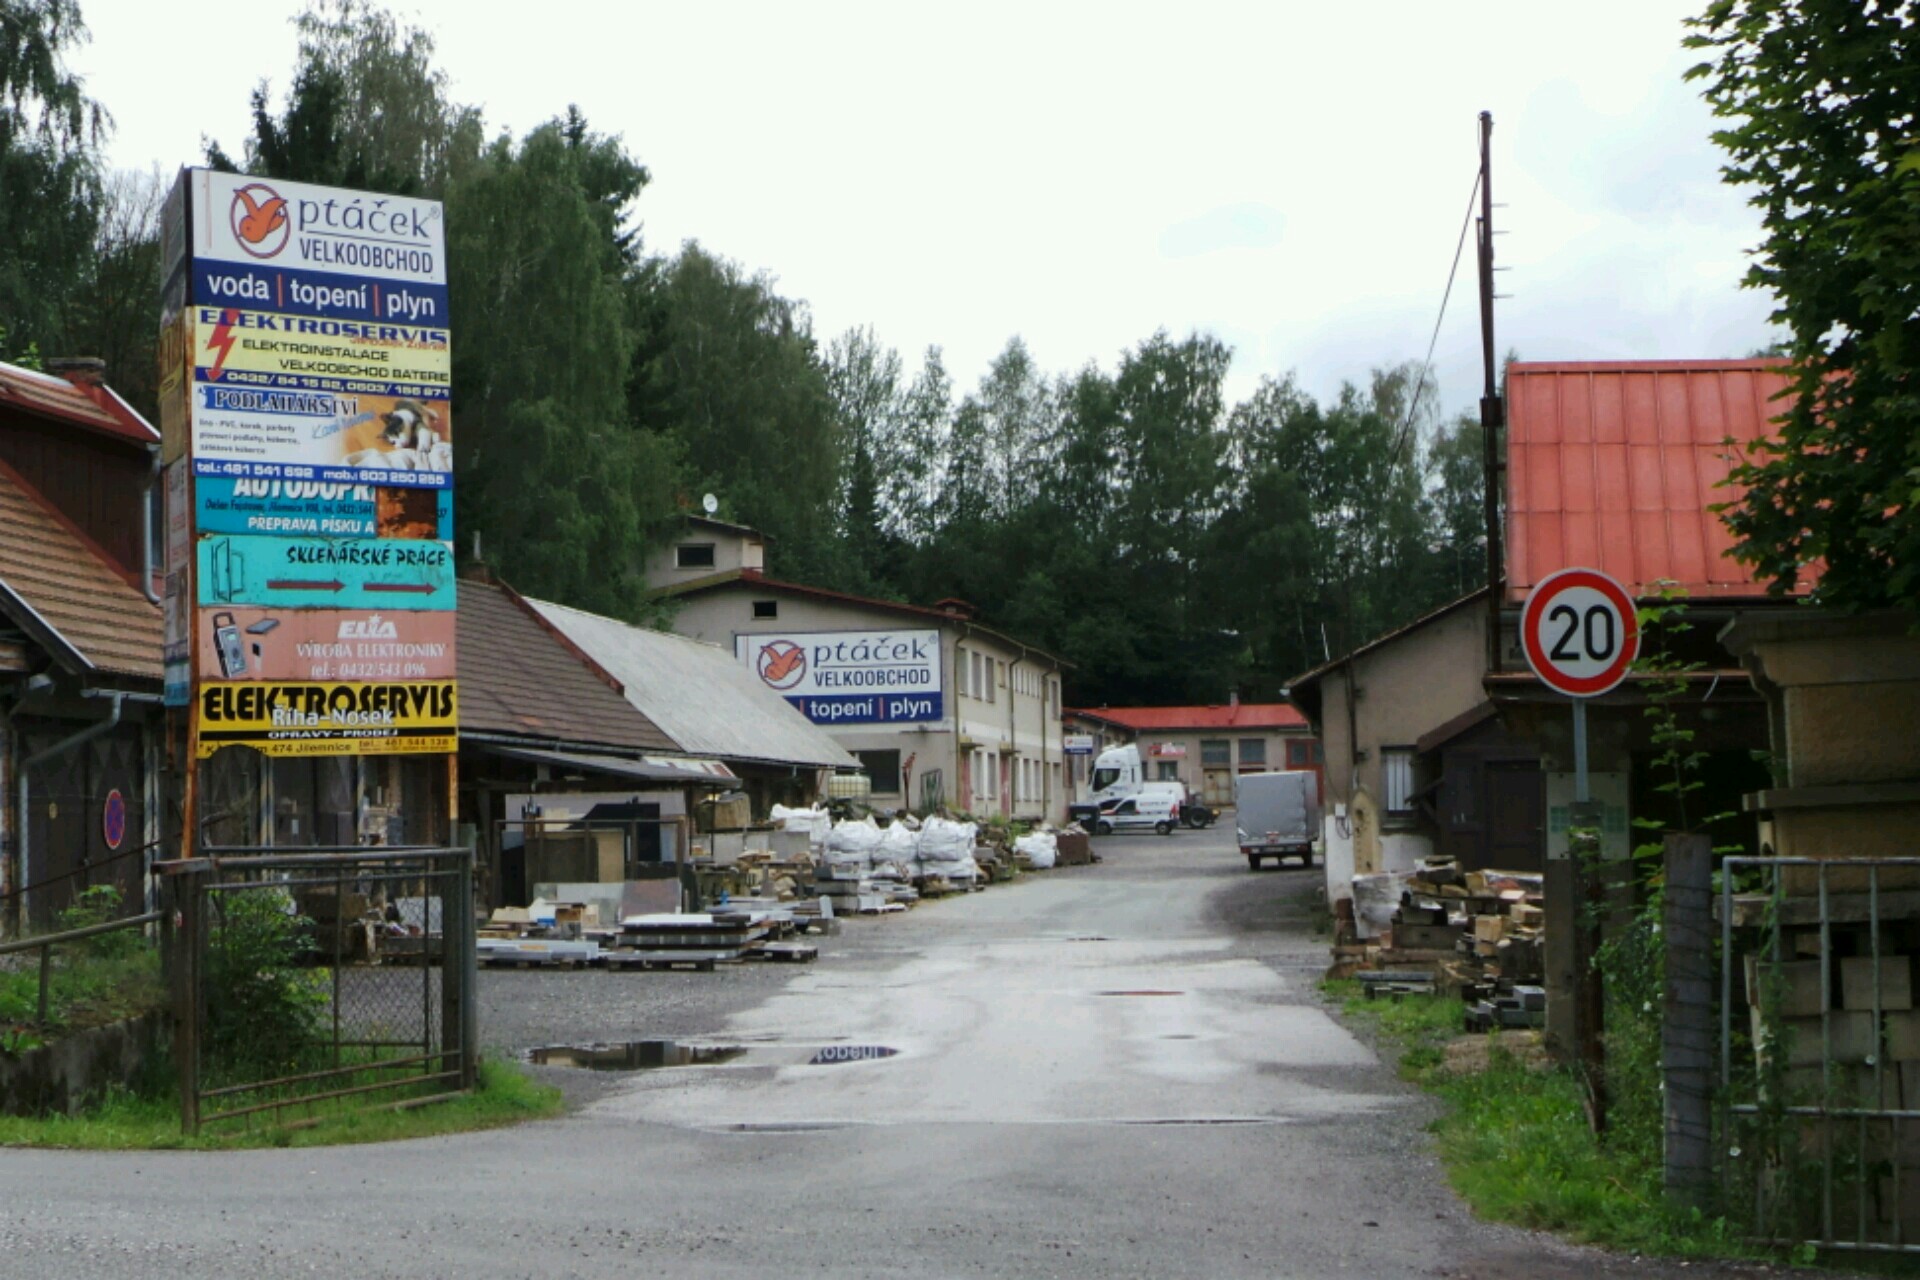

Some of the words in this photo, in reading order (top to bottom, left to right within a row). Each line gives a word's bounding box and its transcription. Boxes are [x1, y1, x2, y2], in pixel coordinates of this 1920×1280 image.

[299, 199, 430, 238] ptáček
[299, 238, 433, 273] VELKOOBCHOD
[207, 273, 269, 300] voda
[290, 278, 366, 310] topení
[387, 290, 435, 320] plyn
[201, 309, 447, 344] ELEKTROSERVIS
[242, 338, 389, 362] ELEKTROINSTALACE
[279, 358, 389, 378] VELKOOBCHOD
[393, 368, 449, 382] BATERIE
[254, 465, 281, 478] 541
[233, 478, 376, 502] AUTODOPR
[248, 513, 317, 532] PŘEPRAVA
[321, 515, 361, 533] PÍSKU
[287, 542, 390, 566] SKLENÁŘSKÉ
[396, 543, 446, 567] PRÁCE
[1548, 604, 1615, 661] 20
[296, 640, 352, 658] VÝROBA
[357, 643, 446, 658] ELEKTRONIKY
[813, 636, 928, 668] ptáček
[813, 669, 931, 688] VELKOOBCHOD
[202, 685, 453, 721] ELEKTROSERVIS
[810, 698, 873, 720] topení
[890, 697, 931, 718] plyn
[296, 743, 352, 754] Jilemnice
